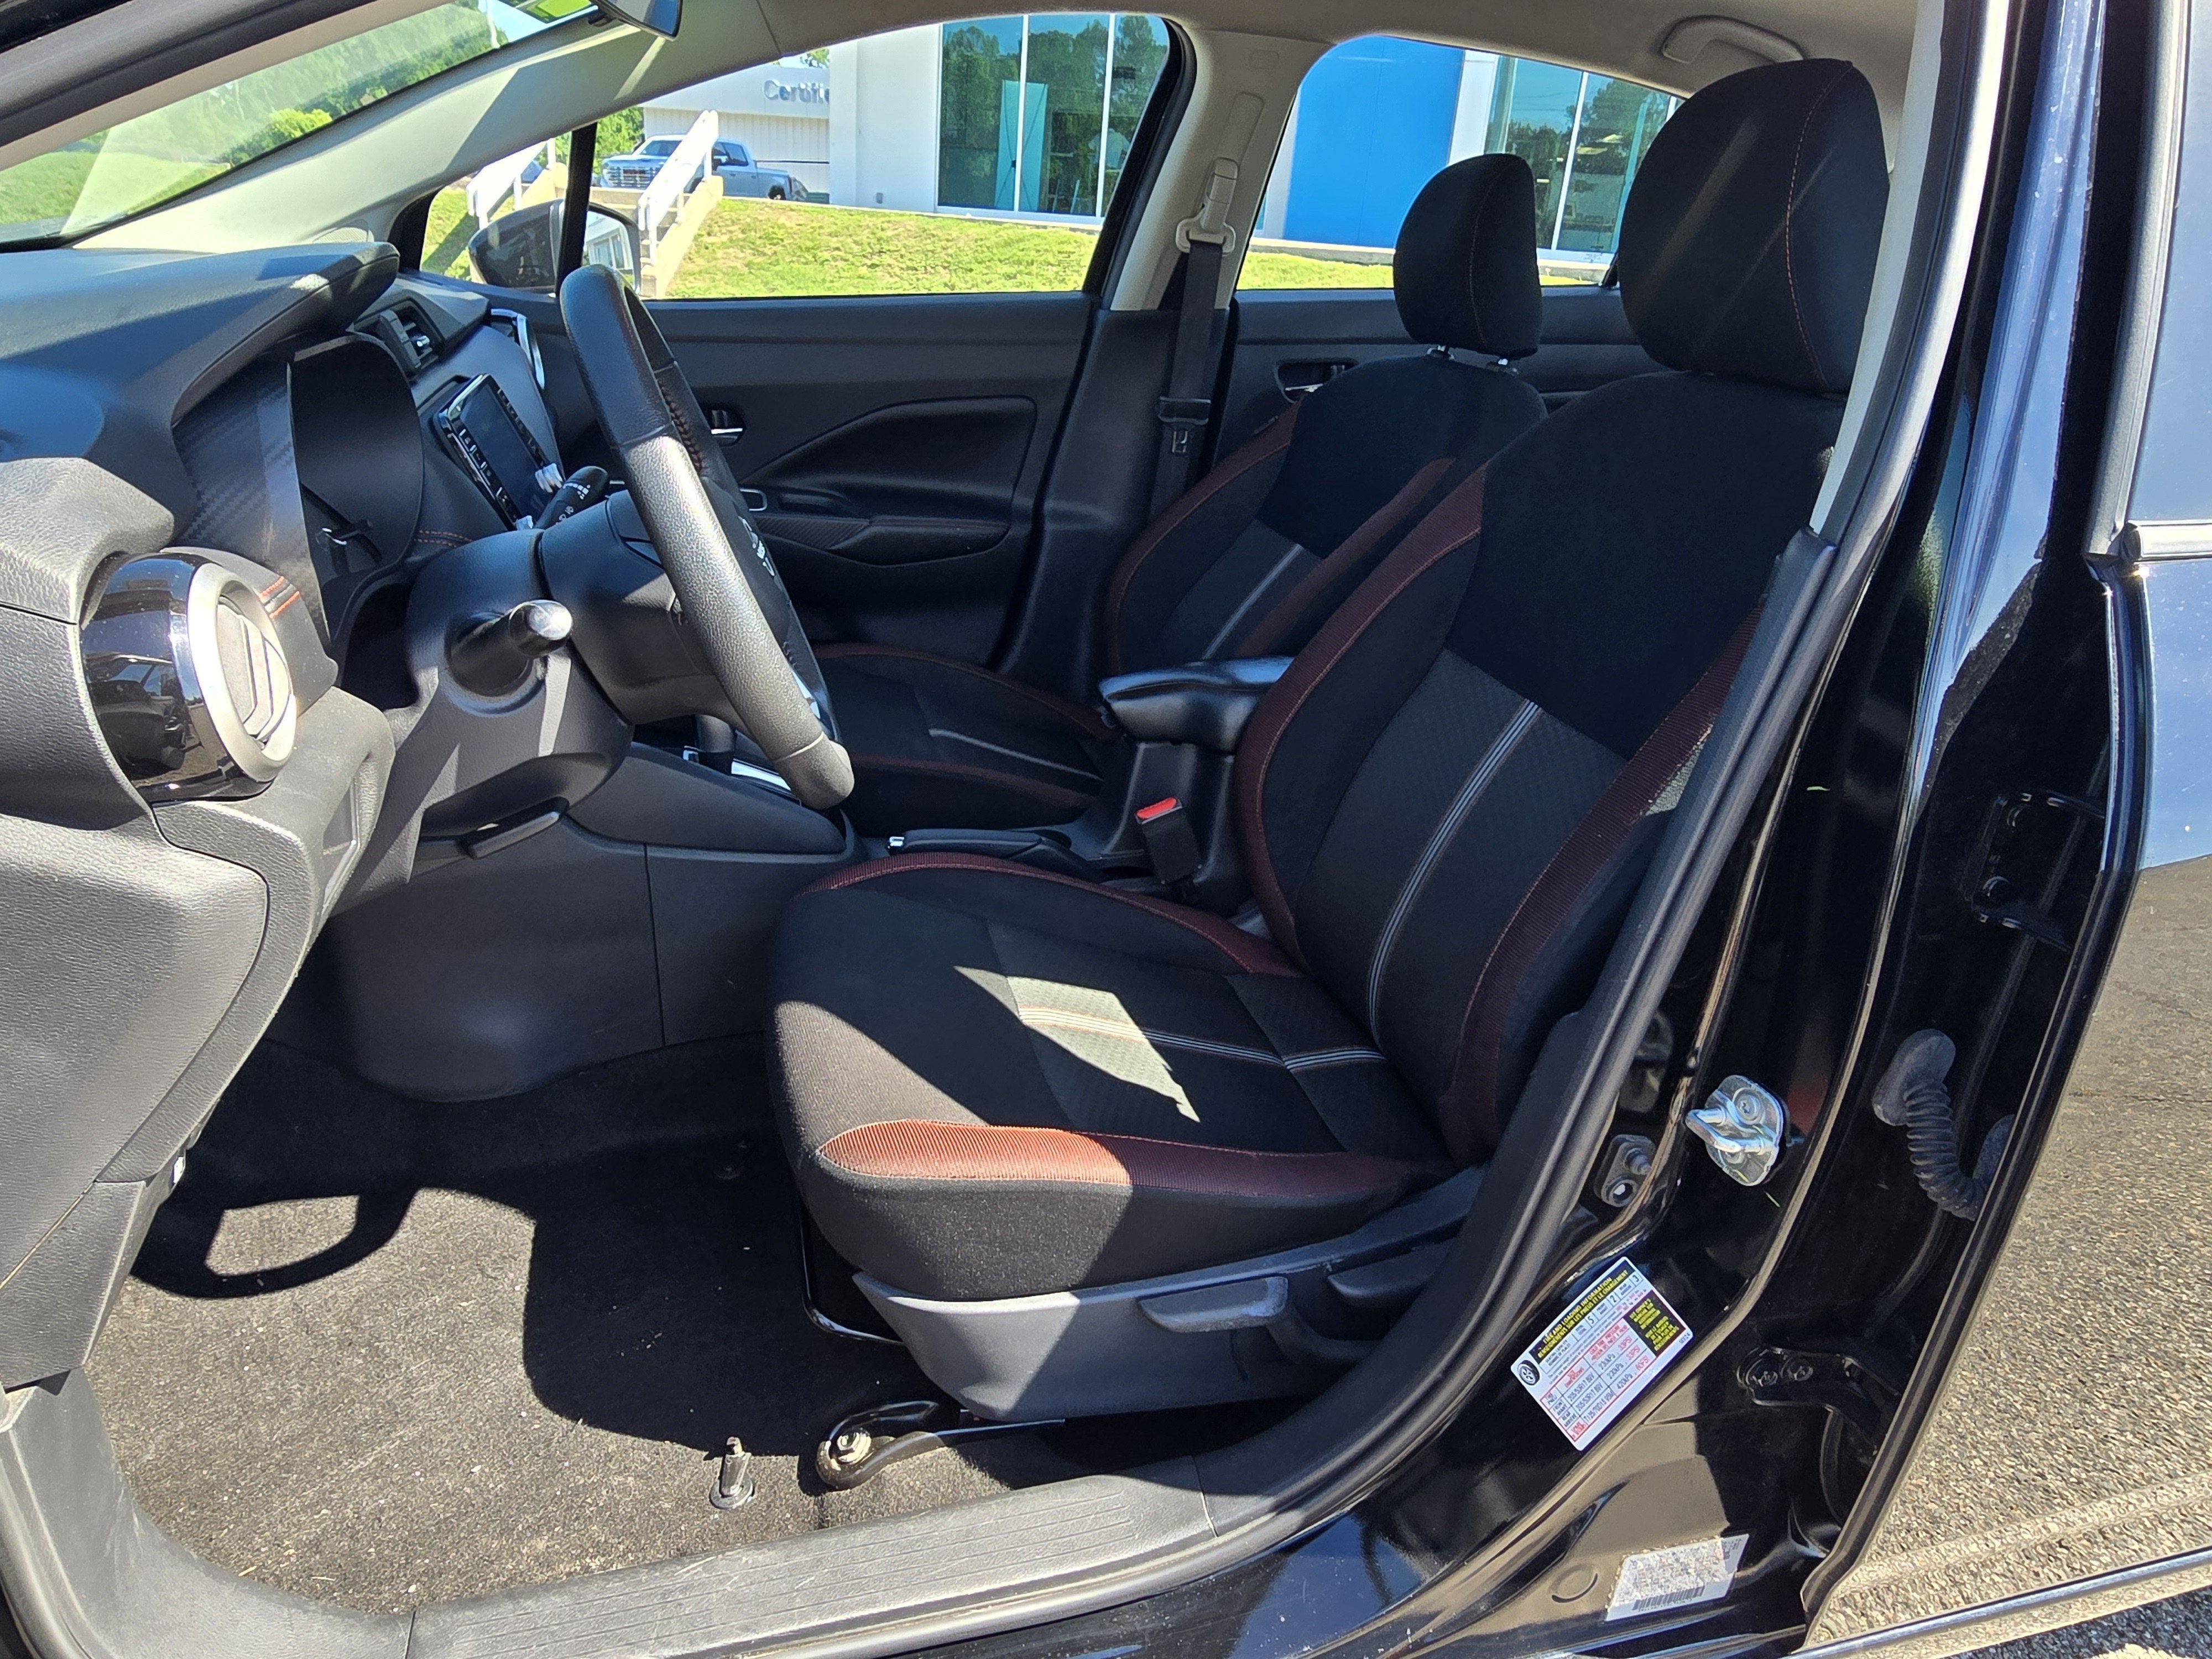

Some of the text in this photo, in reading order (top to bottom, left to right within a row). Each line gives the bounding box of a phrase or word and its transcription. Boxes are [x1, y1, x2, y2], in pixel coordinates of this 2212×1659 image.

[1631, 1274, 1640, 1282] 3
[1609, 1294, 1617, 1303] 2
[1542, 1332, 1554, 1344] TIRE
[1551, 1323, 1563, 1335] AND
[1561, 1304, 1582, 1326] LOADING
[1579, 1275, 1612, 1308] INFORMATION
[1587, 1315, 1595, 1324] 5
